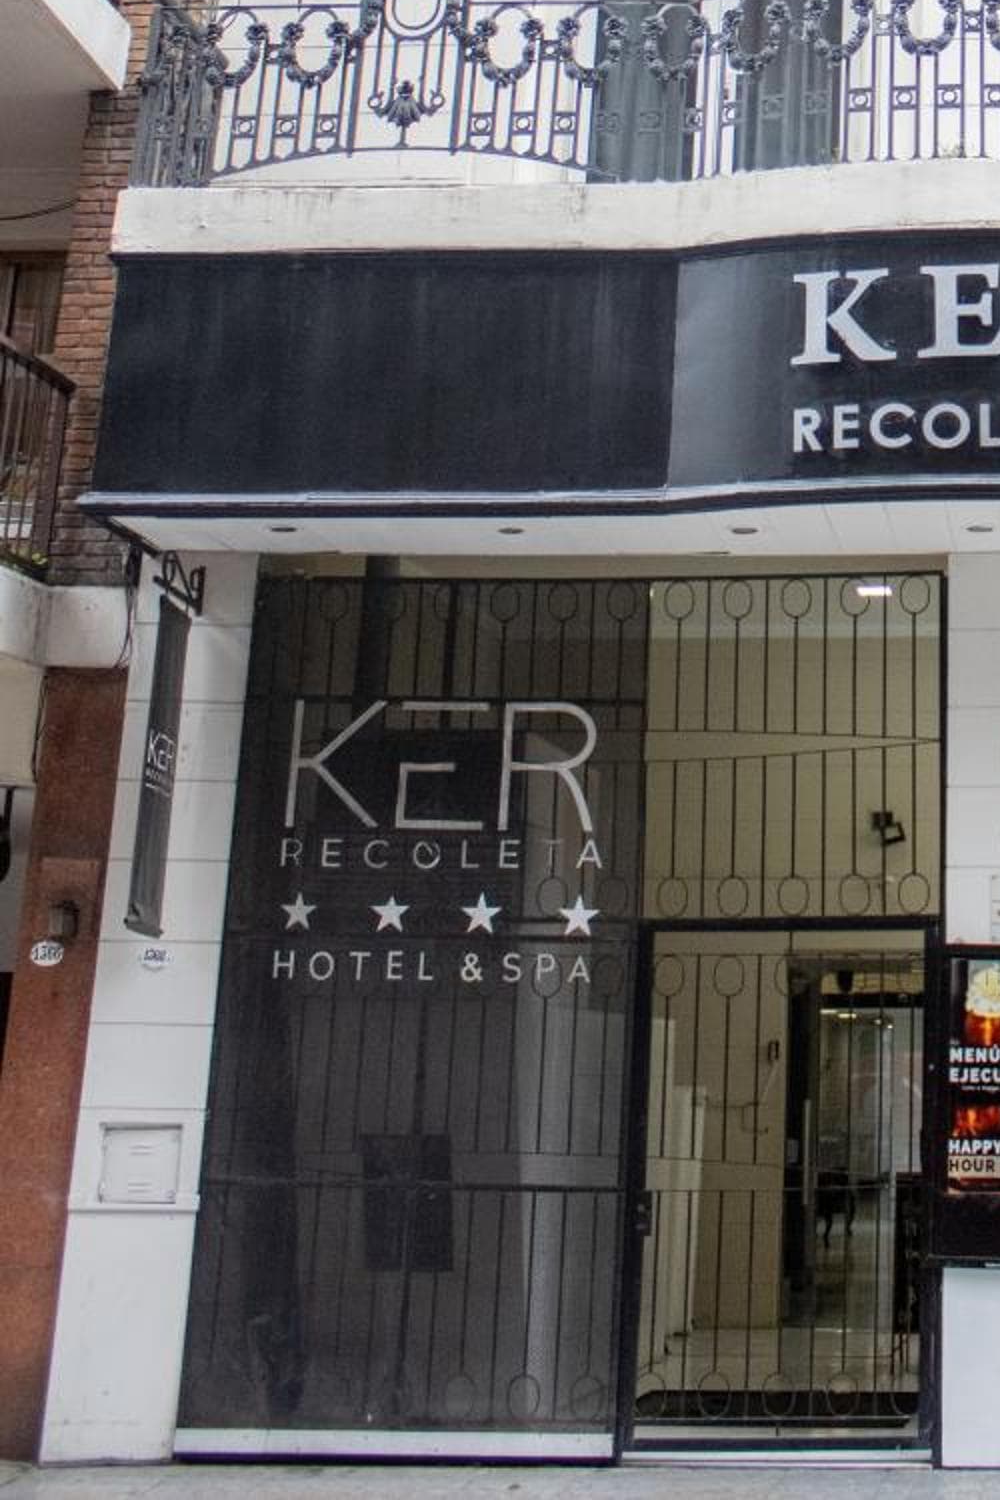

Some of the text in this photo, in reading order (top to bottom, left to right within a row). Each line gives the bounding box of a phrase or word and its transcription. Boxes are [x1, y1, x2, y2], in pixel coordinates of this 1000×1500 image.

[285, 699, 598, 832] KER
[279, 838, 603, 869] RECOLETA
[272, 949, 591, 983] HOTEL & SPA
[949, 1044, 1000, 1063] MENÚ
[948, 1158, 996, 1173] HOUR
